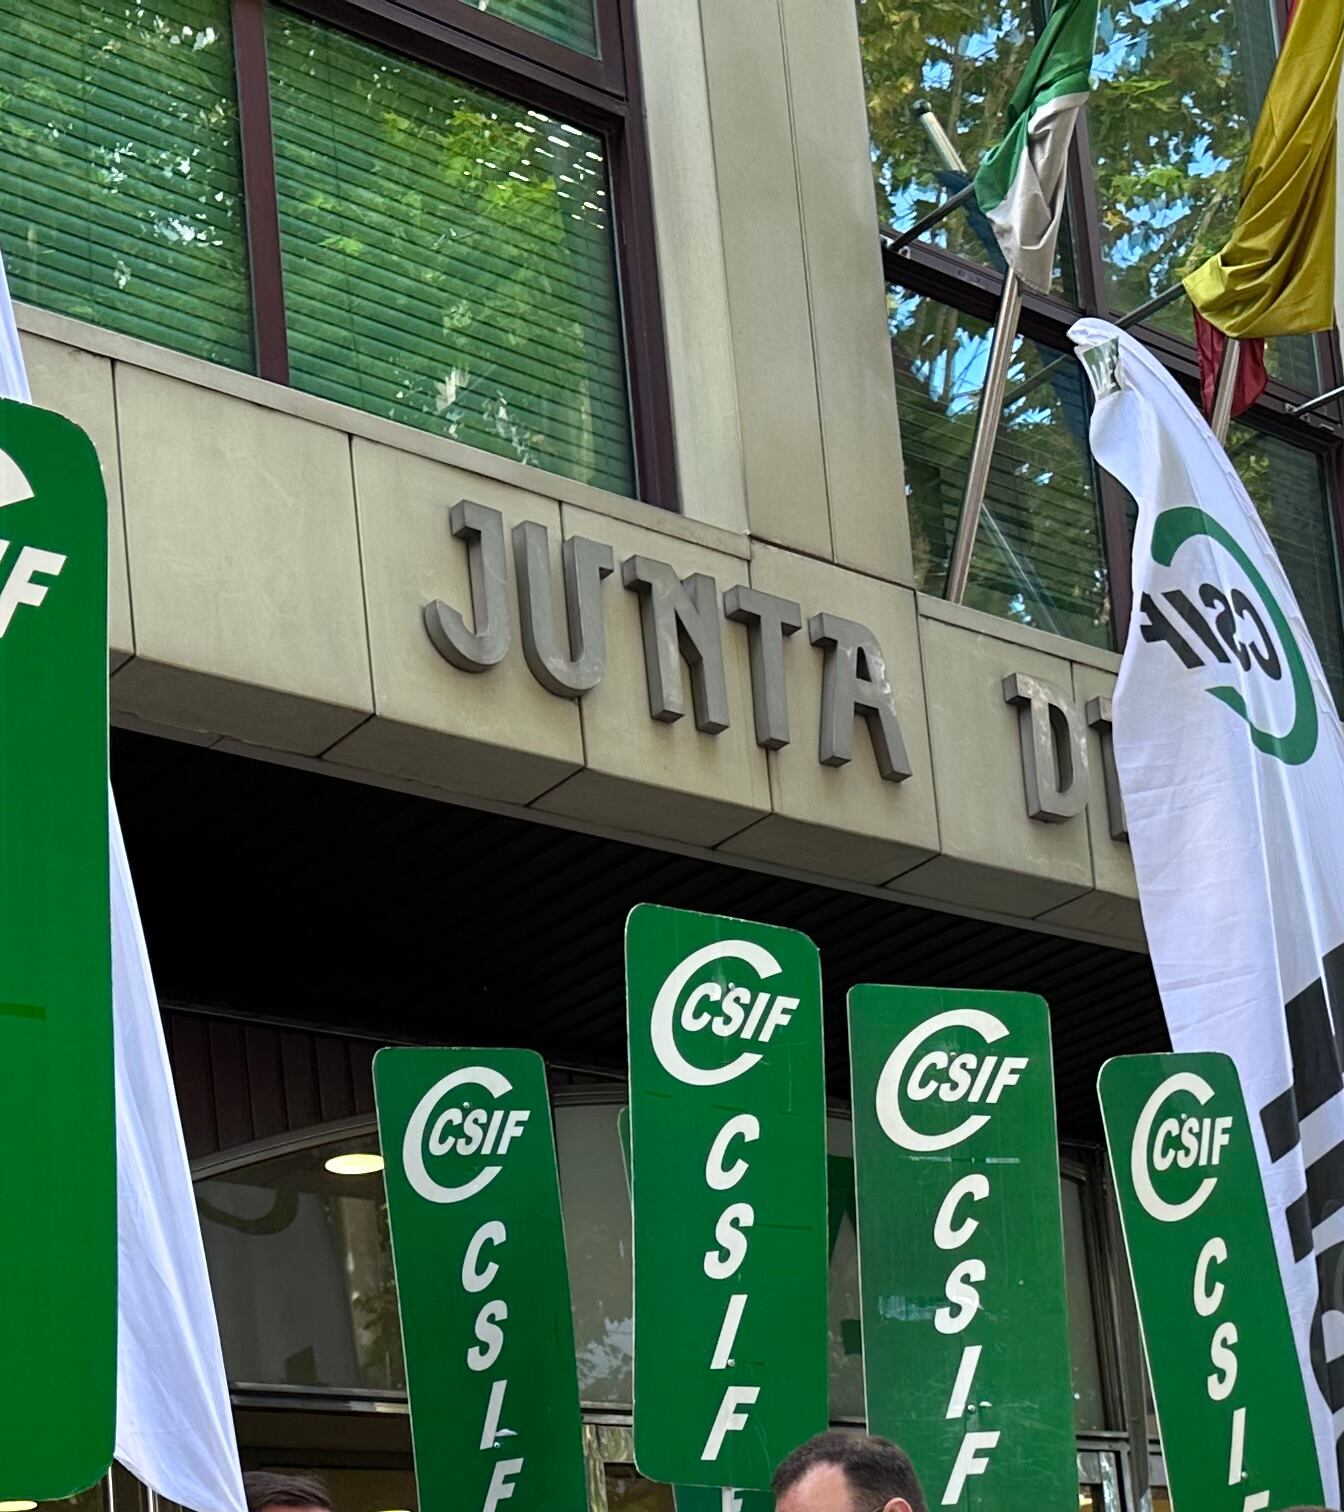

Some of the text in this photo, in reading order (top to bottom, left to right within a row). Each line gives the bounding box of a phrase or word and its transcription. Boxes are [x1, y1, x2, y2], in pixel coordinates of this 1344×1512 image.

[424, 499, 912, 783] JUNTA
[700, 1113, 760, 1462] CSIF
[933, 1173, 1000, 1506] CSIF
